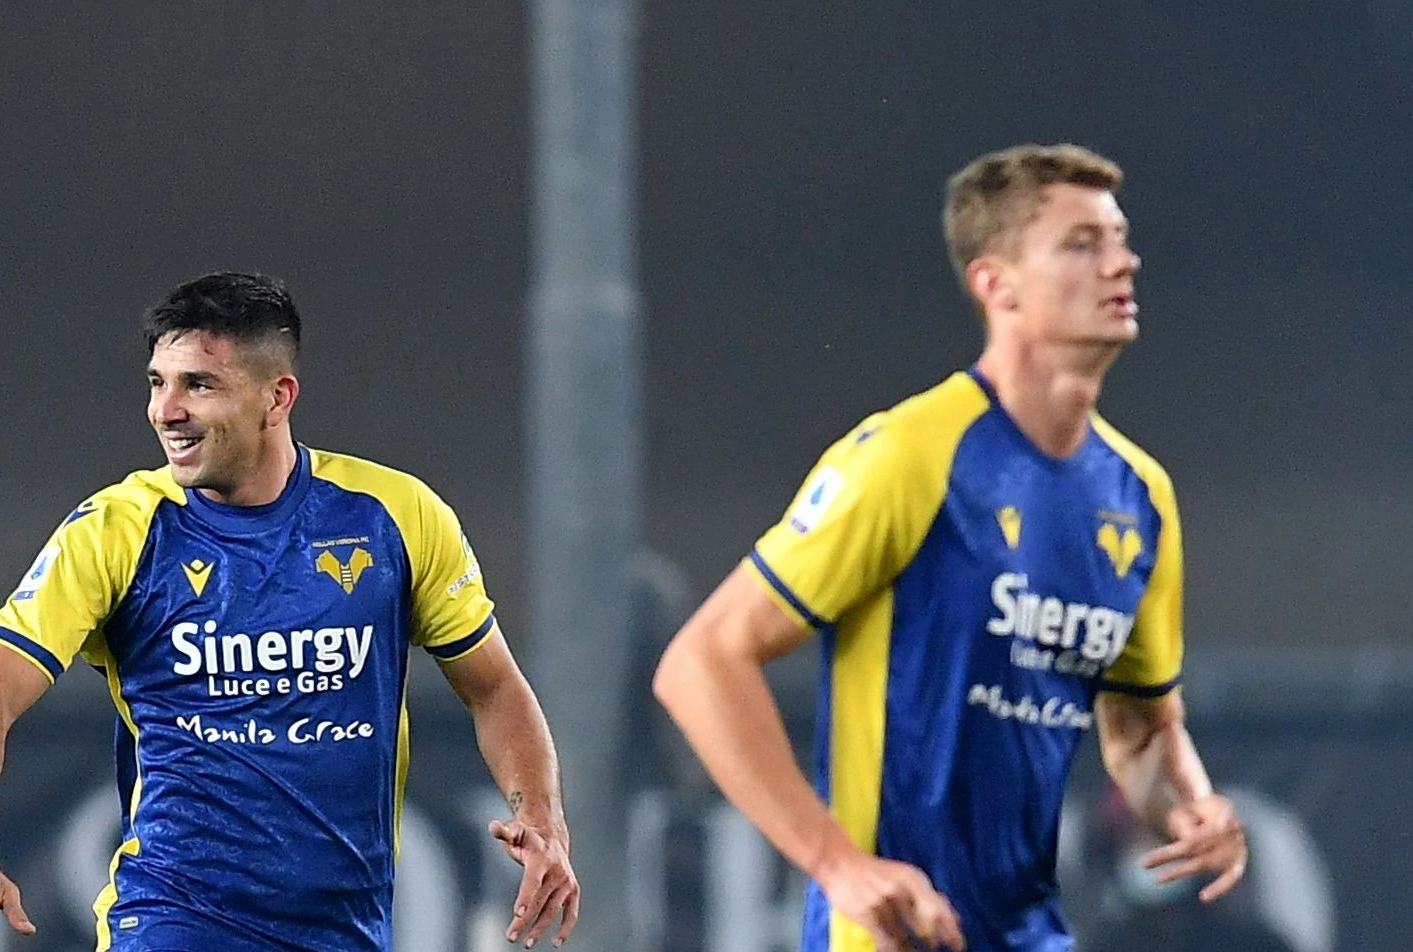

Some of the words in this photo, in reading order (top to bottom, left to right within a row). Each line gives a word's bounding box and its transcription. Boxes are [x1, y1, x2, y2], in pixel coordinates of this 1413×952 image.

[171, 620, 373, 678] Sinergy
[208, 676, 270, 696] Luce
[277, 678, 291, 693] e
[297, 671, 344, 693] Gas
[176, 714, 276, 744] Manila
[287, 717, 375, 744] Grace
